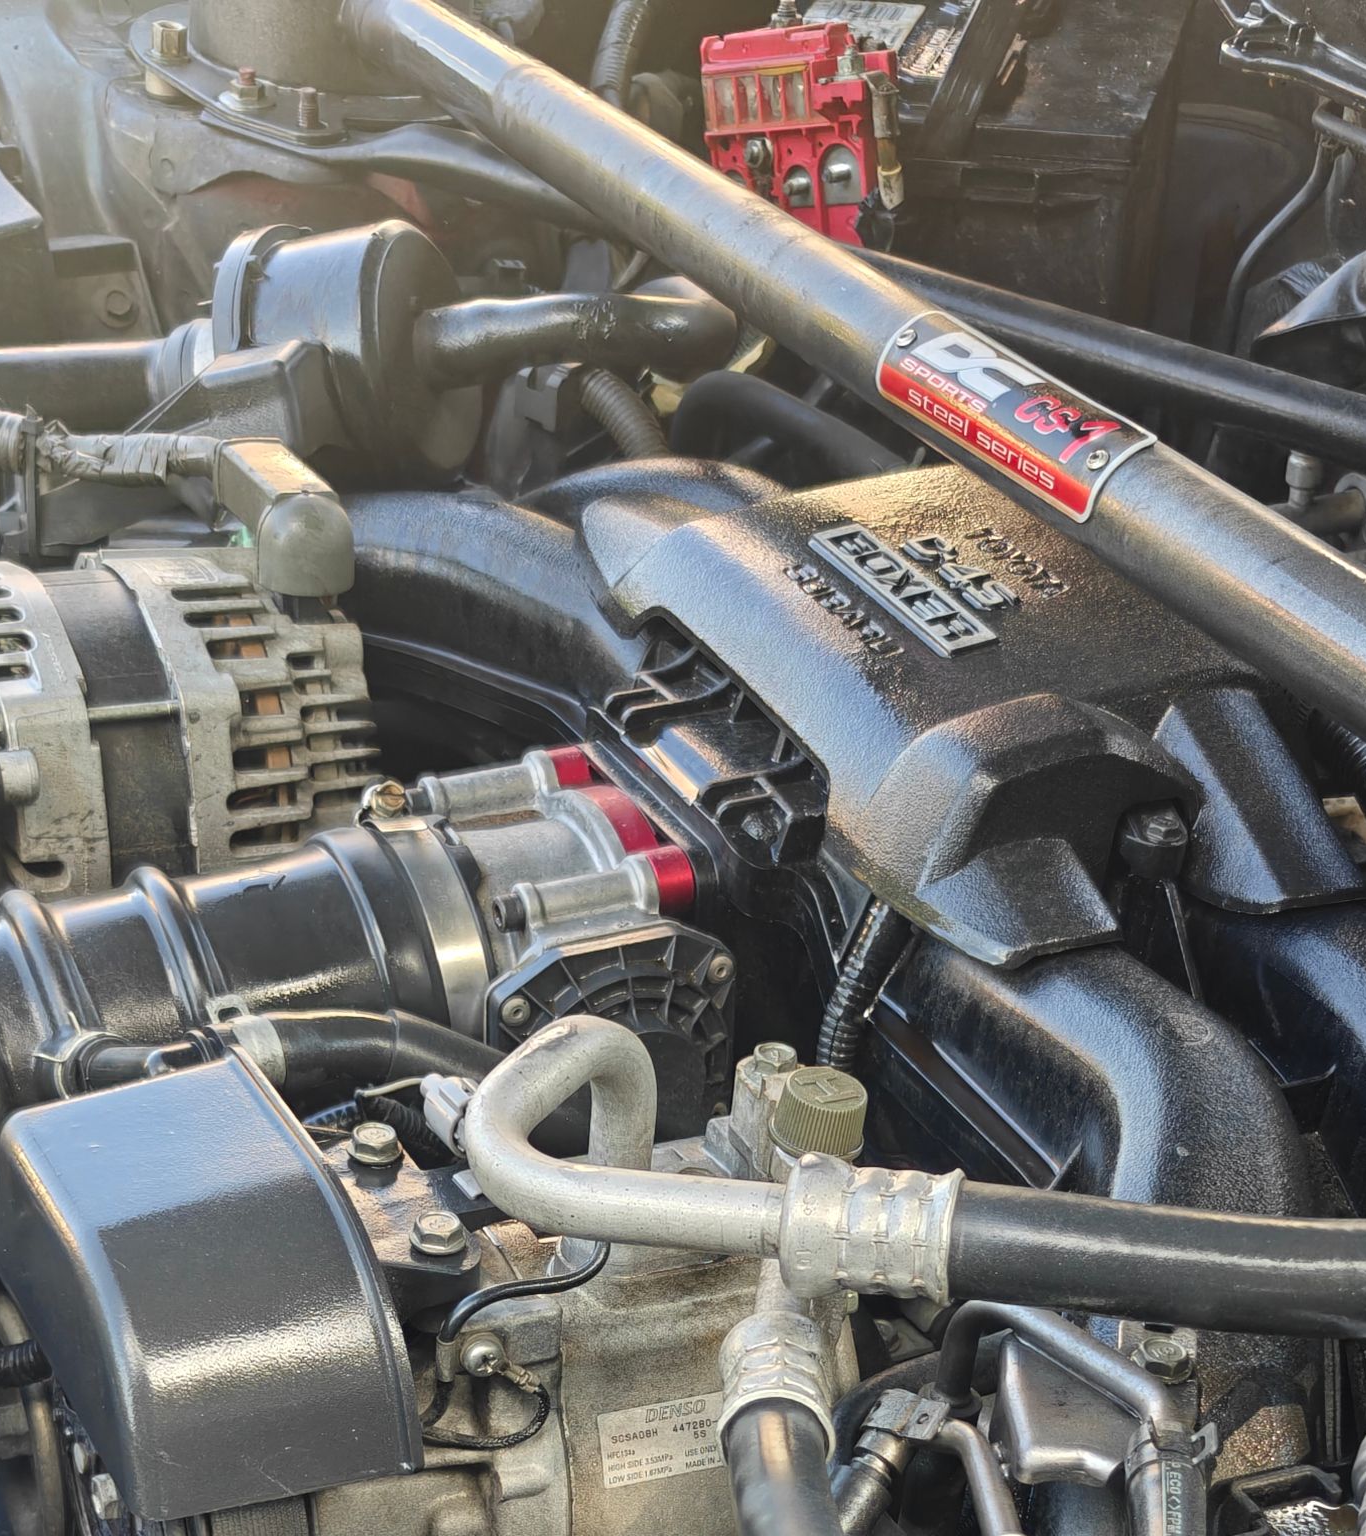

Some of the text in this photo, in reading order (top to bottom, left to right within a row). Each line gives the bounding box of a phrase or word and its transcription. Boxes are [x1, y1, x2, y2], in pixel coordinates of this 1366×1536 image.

[899, 357, 987, 414] SPORTS
[907, 388, 1055, 490] steel series
[825, 530, 982, 644] BOXER
[784, 563, 904, 658] SUBARU
[645, 1399, 706, 1423] DENSO
[684, 1447, 699, 1457] USE
[685, 1458, 705, 1469] MADE
[608, 1474, 625, 1485] LOW
[626, 1470, 644, 1481] SIDE
